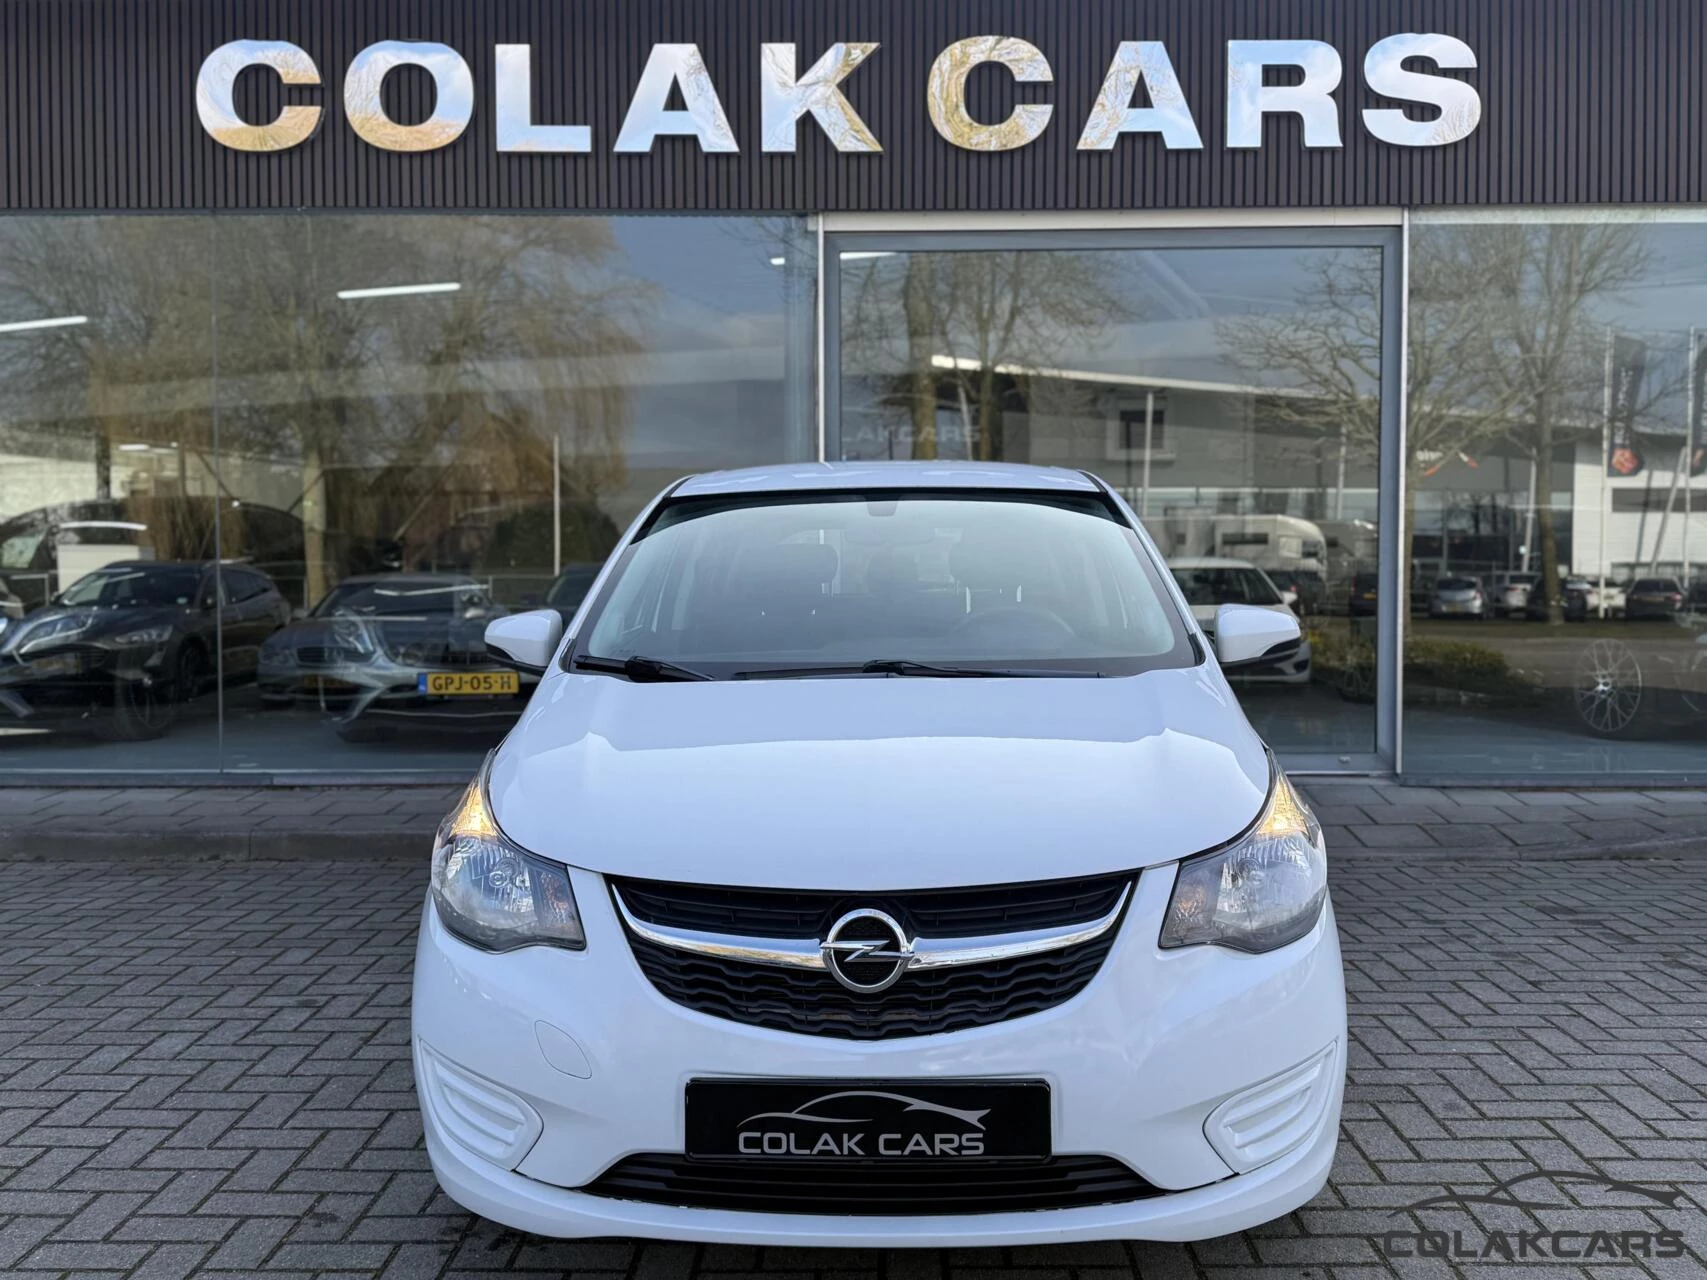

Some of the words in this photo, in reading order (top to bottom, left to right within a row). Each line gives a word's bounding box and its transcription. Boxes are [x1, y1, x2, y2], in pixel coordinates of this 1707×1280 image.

[196, 39, 882, 153] COLAK
[926, 32, 1482, 153] CARS
[432, 675, 512, 691] GPJ-05-H
[738, 1131, 865, 1156] COLAK
[878, 1132, 985, 1156] CARS
